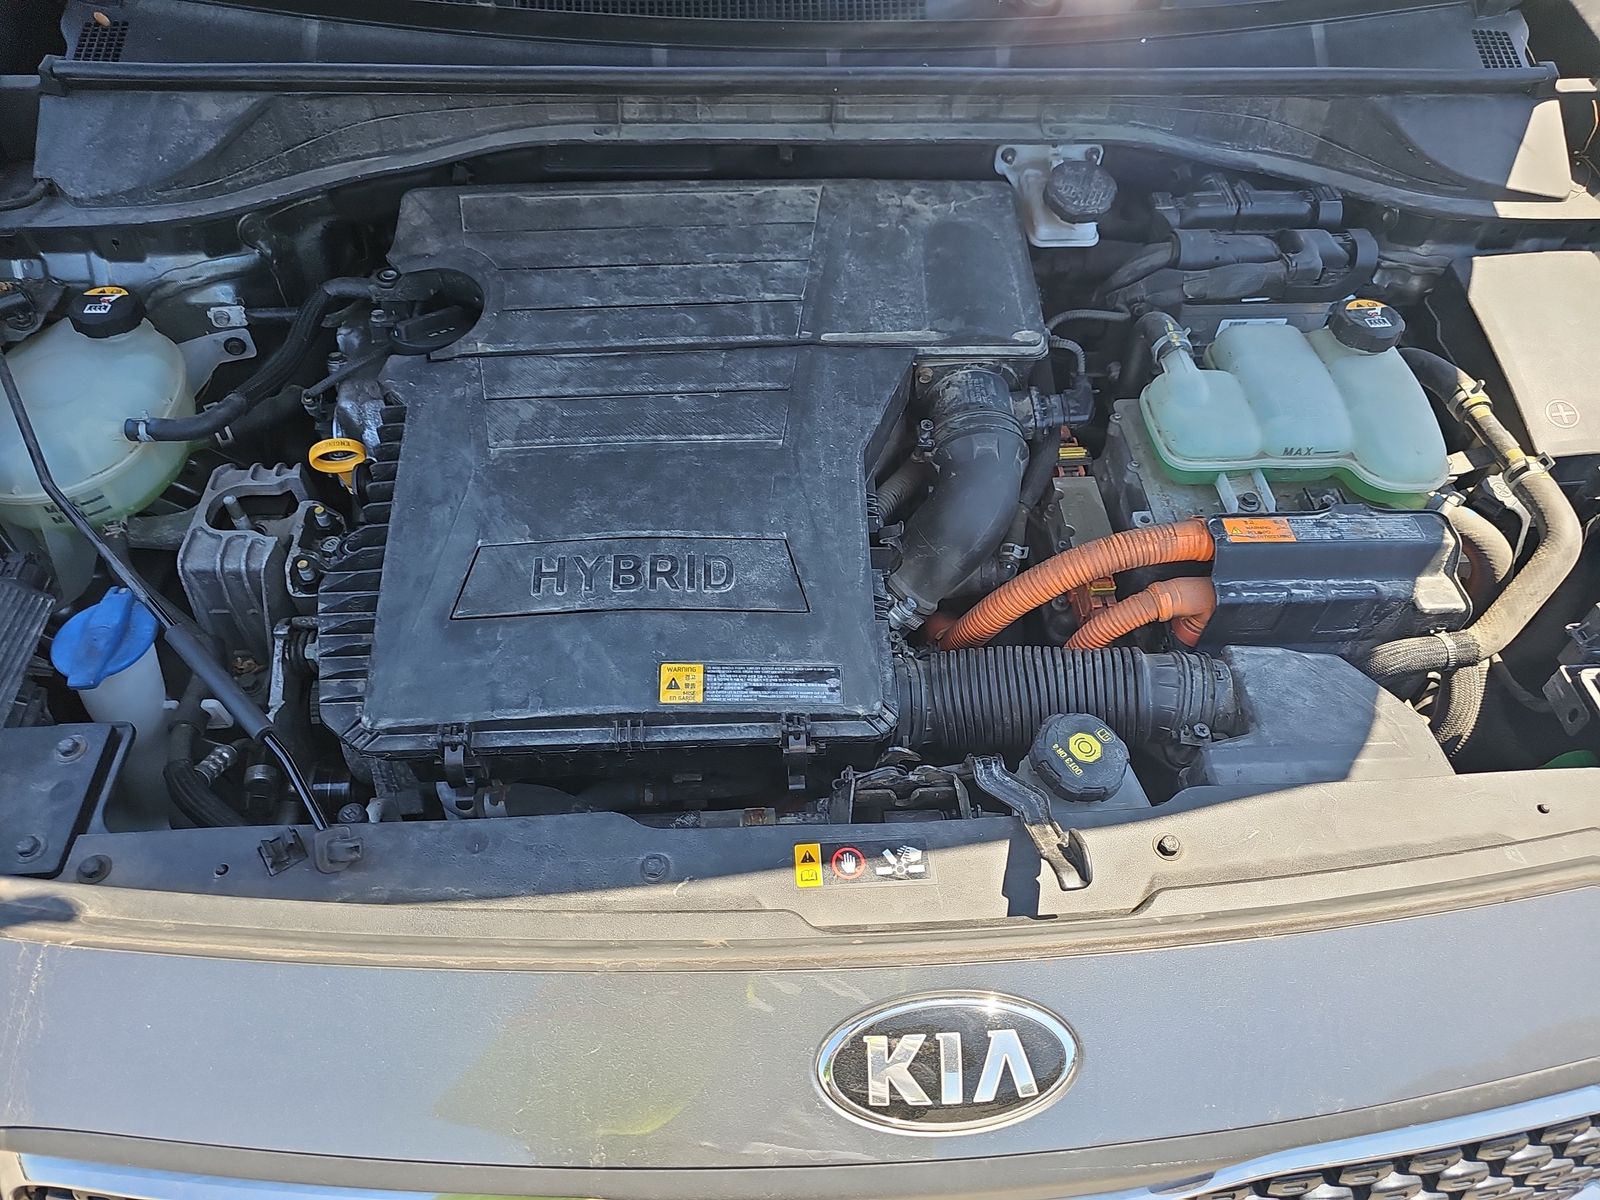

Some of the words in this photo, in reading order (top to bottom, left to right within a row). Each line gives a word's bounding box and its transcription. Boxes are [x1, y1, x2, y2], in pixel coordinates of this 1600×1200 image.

[1282, 447, 1314, 456] MAX
[531, 554, 735, 596] HYBRID
[1056, 747, 1068, 758] OR
[863, 1029, 1039, 1107] KIA
